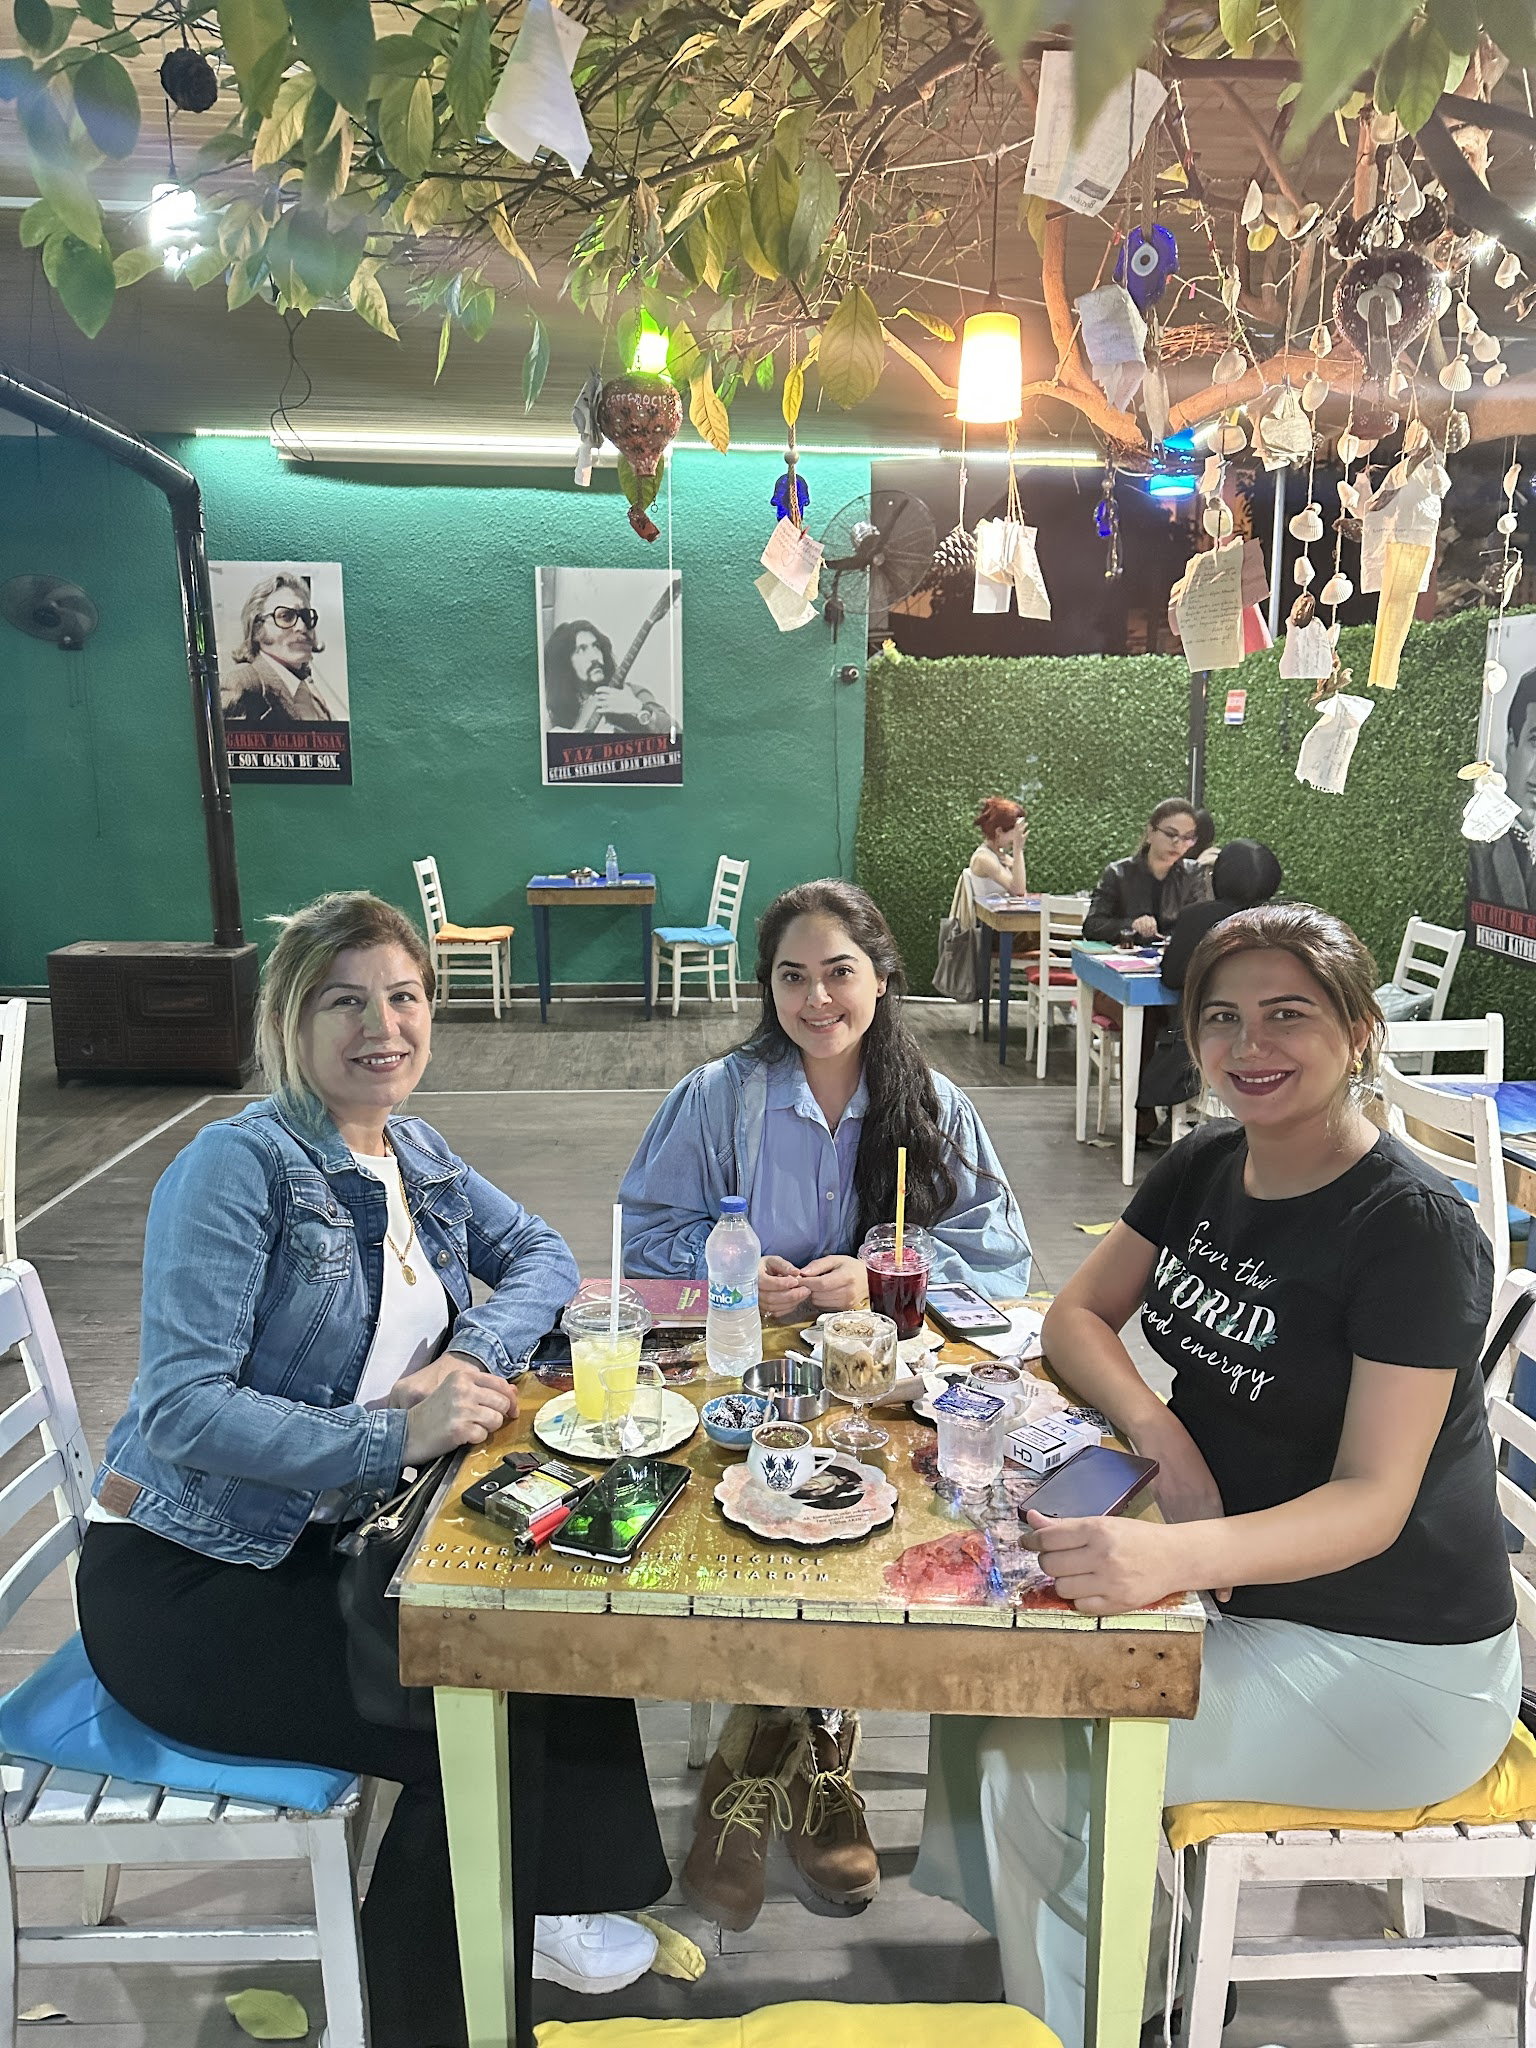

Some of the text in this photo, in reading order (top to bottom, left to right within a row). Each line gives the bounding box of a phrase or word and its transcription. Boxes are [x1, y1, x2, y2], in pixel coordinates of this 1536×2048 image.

[238, 754, 258, 766] SON
[263, 754, 294, 767] OLSUN
[299, 754, 313, 767] BU
[317, 754, 340, 768] SON.
[562, 736, 668, 763] YAZ DOSTUM
[1187, 1220, 1278, 1291] Give this
[1154, 1244, 1277, 1347] WORLD
[1179, 1336, 1276, 1402] energy
[412, 1558, 553, 1575] FELAKETİM
